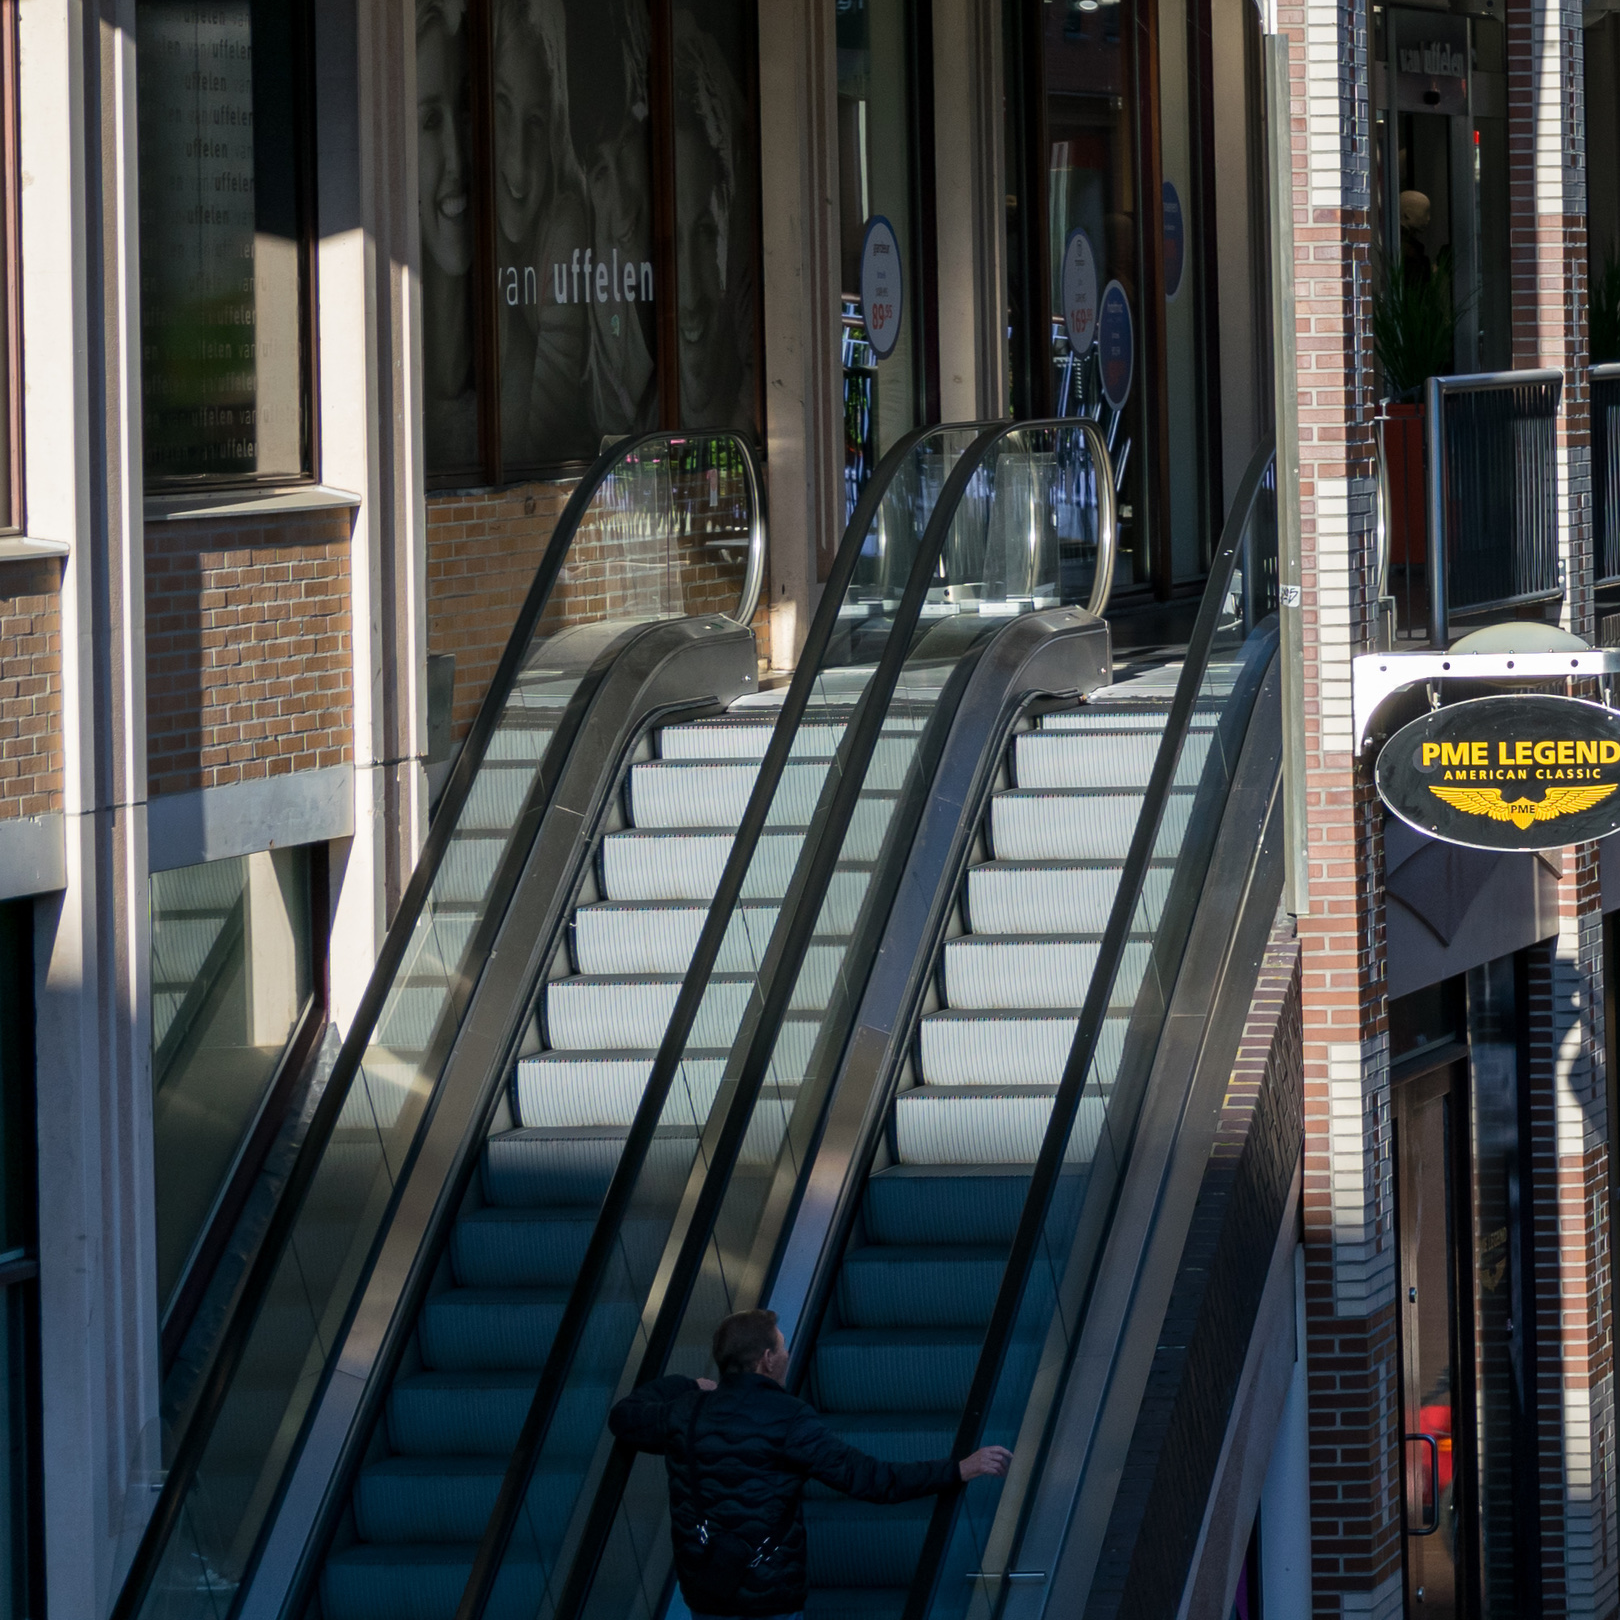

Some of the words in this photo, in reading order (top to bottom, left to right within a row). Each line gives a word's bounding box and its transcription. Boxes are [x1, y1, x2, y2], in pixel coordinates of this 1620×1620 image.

[553, 248, 654, 304] uffelen
[1422, 741, 1489, 766] PME
[1443, 769, 1527, 780] AMERICAN
[1535, 768, 1601, 779] CLASSIC
[1510, 804, 1536, 814] PME
